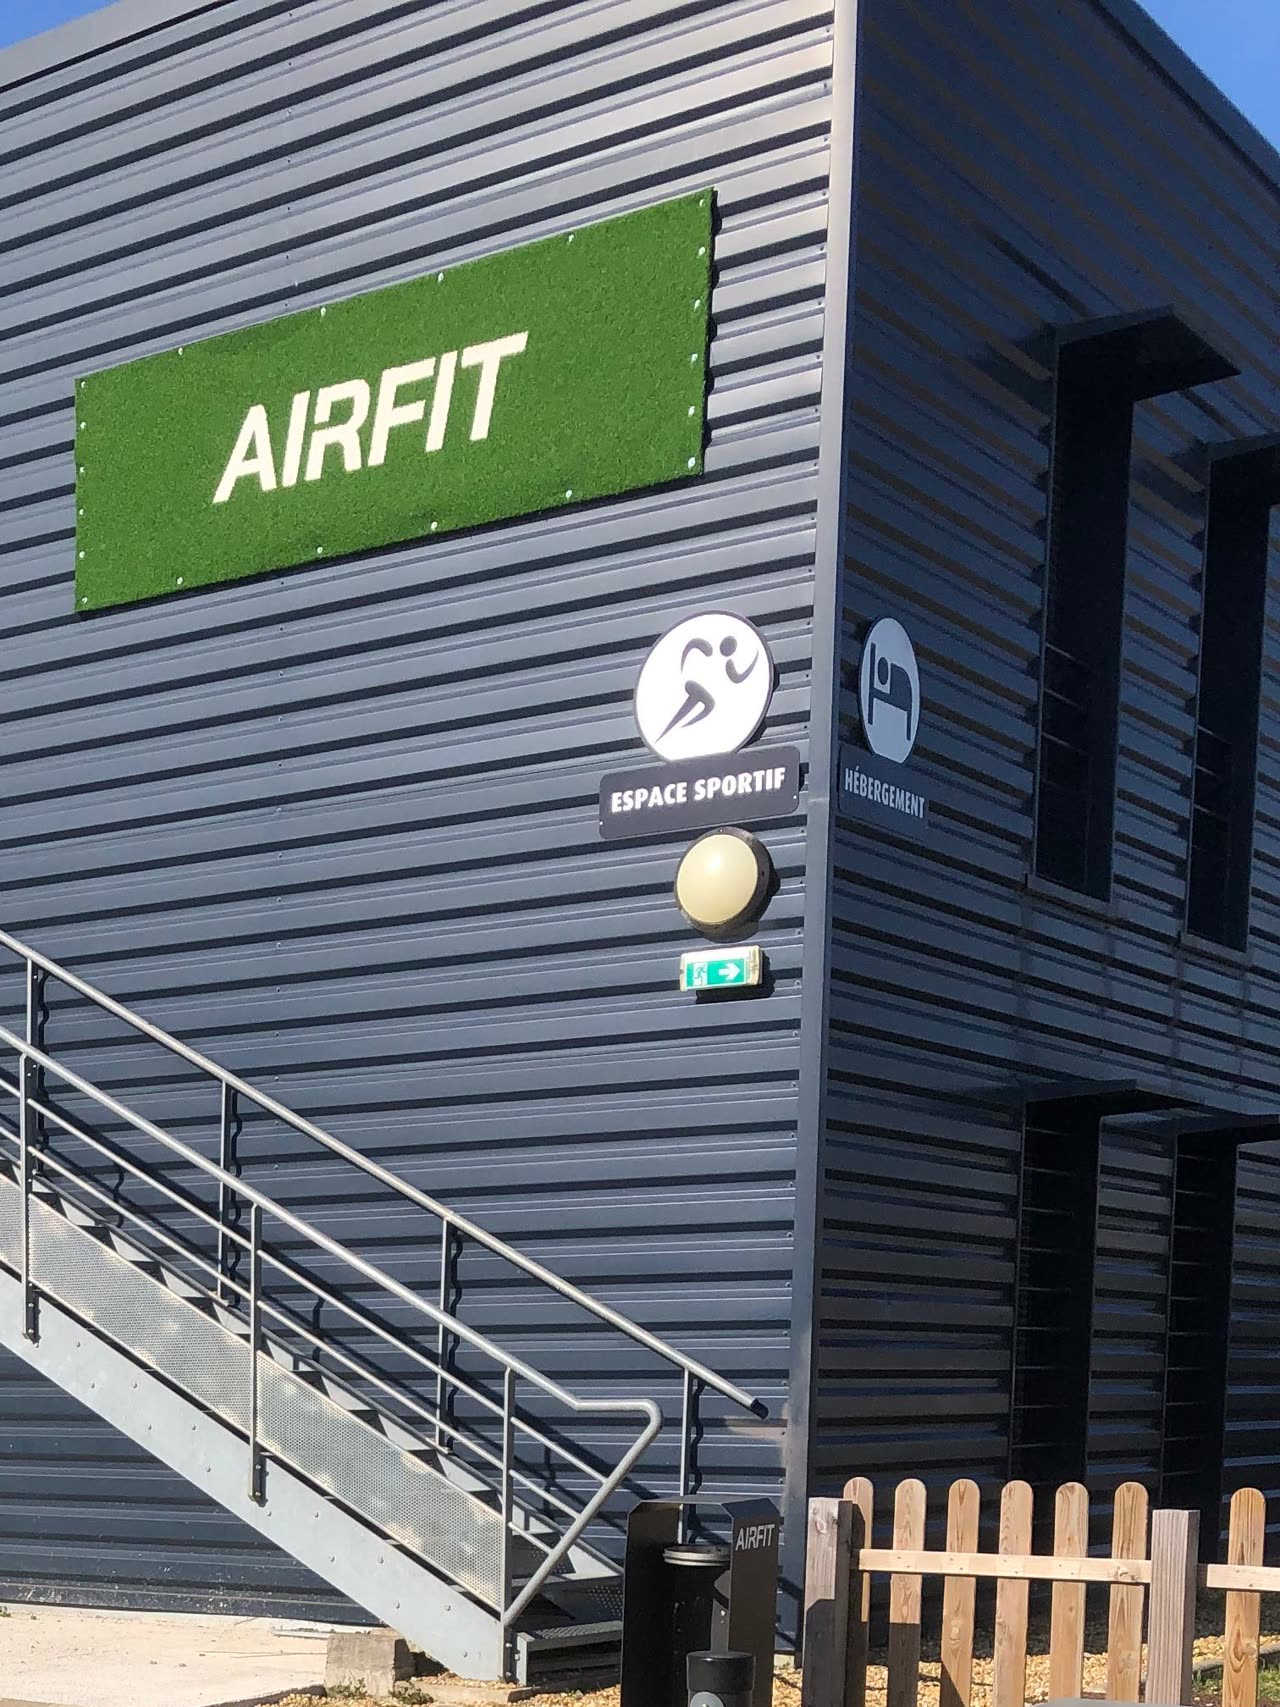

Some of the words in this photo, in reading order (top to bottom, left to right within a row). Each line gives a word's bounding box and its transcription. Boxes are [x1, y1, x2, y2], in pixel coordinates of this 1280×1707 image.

[212, 331, 529, 504] AIRFIT
[611, 782, 687, 813] ESPACE
[694, 767, 786, 801] SPORTIF
[844, 765, 925, 819] HÉBERGEMENT
[735, 1523, 776, 1551] AIRFIT
